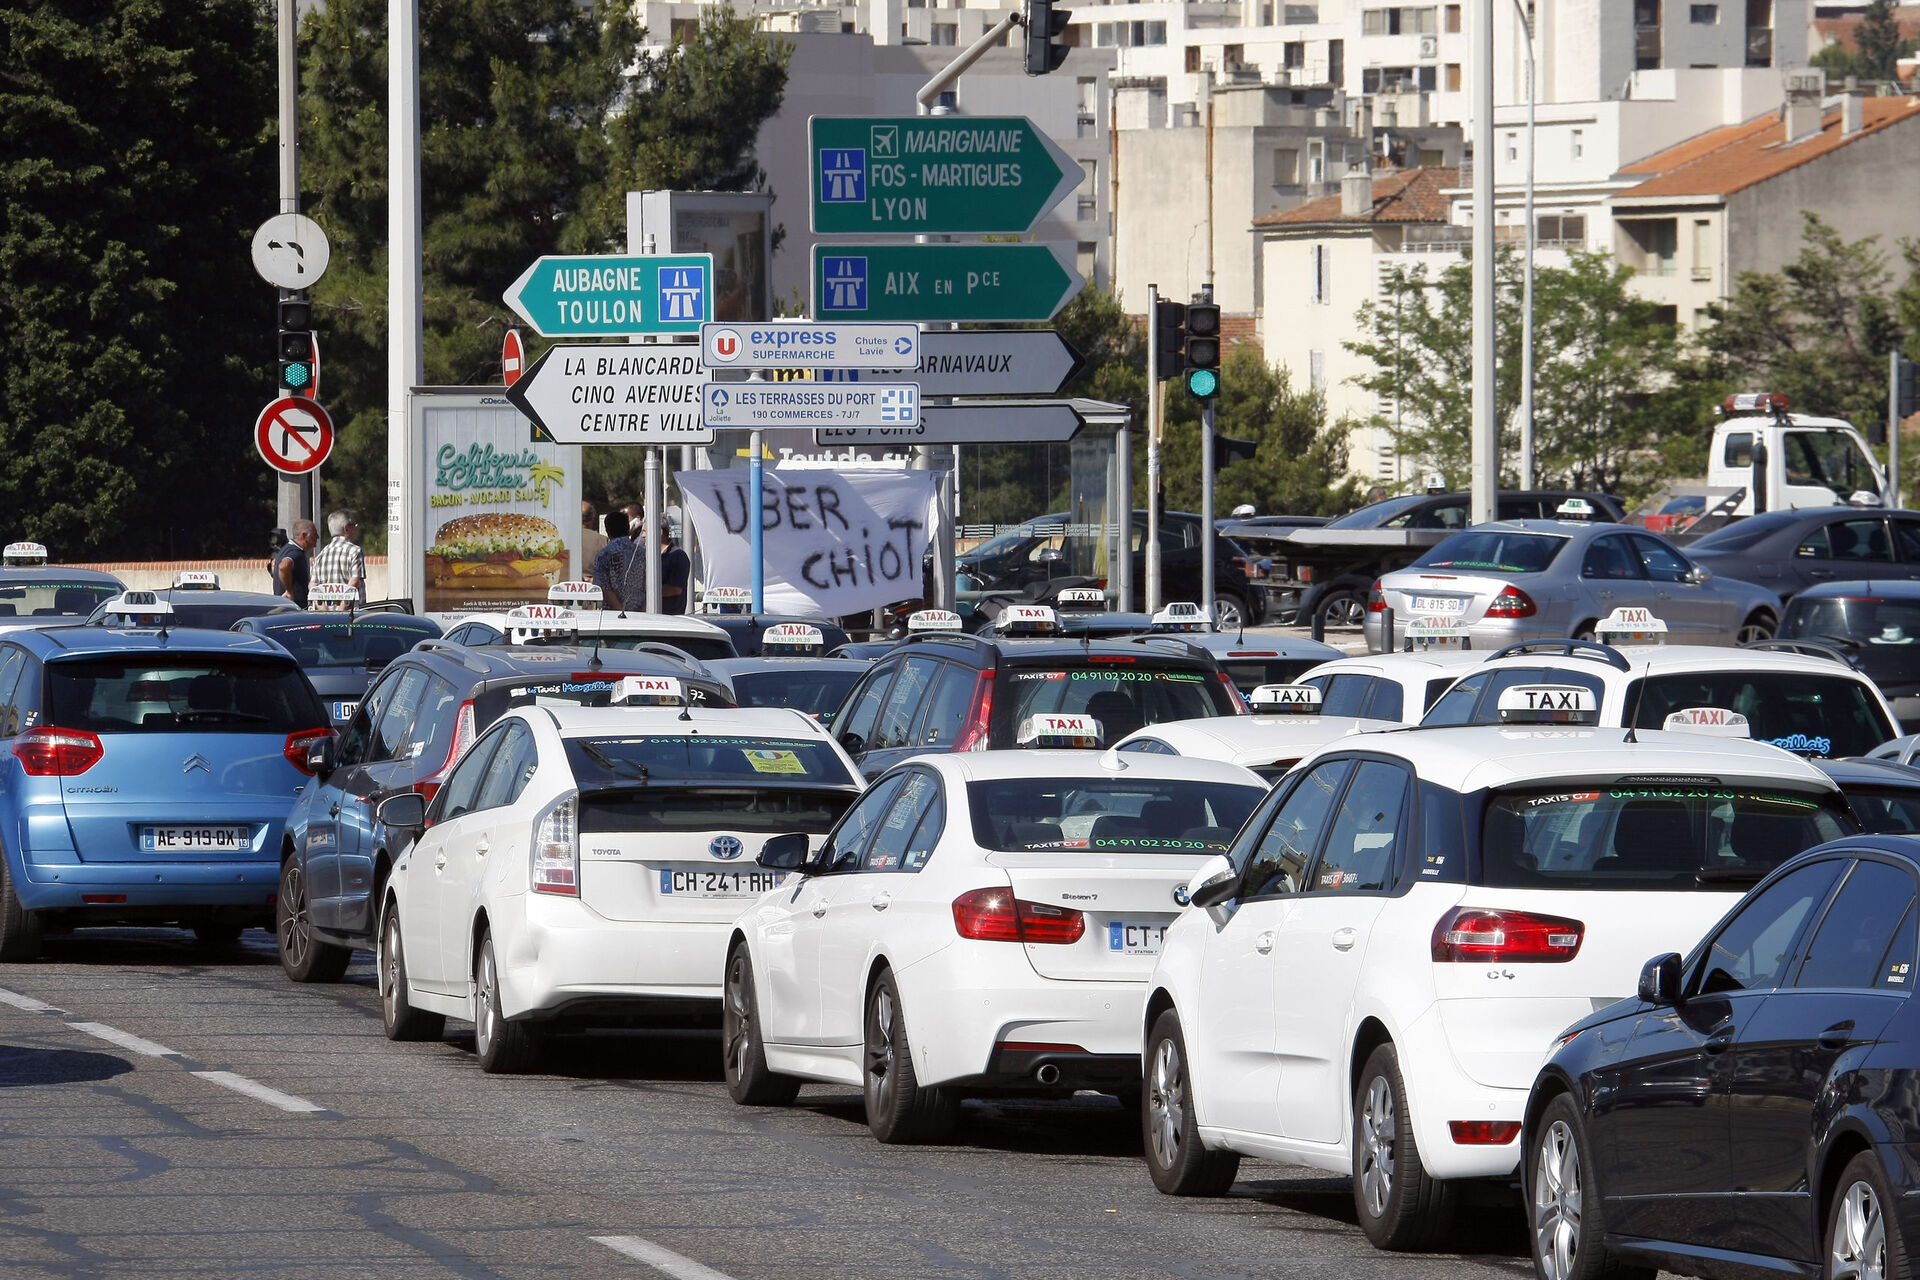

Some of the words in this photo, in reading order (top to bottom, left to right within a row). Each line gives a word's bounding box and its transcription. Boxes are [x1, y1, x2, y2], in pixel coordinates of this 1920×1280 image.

[905, 131, 1022, 153] MARIGNANE
[872, 164, 906, 187] FOS
[922, 164, 1022, 187] MARTIGUES
[872, 198, 927, 221] LYON
[553, 268, 641, 292] AUBAGNE
[885, 272, 919, 295] AIX
[935, 280, 952, 295] EN
[557, 300, 642, 324] TOULON
[751, 330, 837, 348] express
[855, 336, 888, 345] Chutes
[752, 350, 835, 360] SUPERMARCHE
[859, 347, 884, 356] Lavie
[564, 358, 586, 376] LA
[571, 385, 615, 404] CINQ
[736, 393, 757, 405] LES
[759, 393, 825, 405] TERRASSES
[828, 393, 843, 405] DU
[846, 393, 876, 405] PORT
[752, 410, 768, 419] 190
[770, 410, 833, 419] COMMERCES
[842, 410, 860, 419] 7J/7
[580, 414, 650, 432] CENTRE
[436, 441, 541, 475] California
[430, 493, 463, 509] BACON
[470, 489, 512, 505] AVOCADO
[713, 484, 849, 534] UBER
[322, 585, 345, 593] TAXI
[564, 583, 588, 593] TAXI
[129, 592, 155, 605] TAXI
[1071, 592, 1097, 600] TAXI
[526, 607, 557, 619] TAXI
[1017, 609, 1045, 617] TAXI
[1172, 604, 1196, 615] TAXI
[924, 612, 947, 621] TAXI
[1424, 617, 1451, 628] TAXI
[1619, 610, 1647, 623] TAXI
[781, 625, 806, 635] TAXI
[1071, 672, 1088, 681] 04
[1090, 672, 1102, 681] 91
[1104, 672, 1119, 681] 02
[1120, 672, 1135, 681] 20
[1137, 673, 1152, 682] 20
[635, 681, 669, 690] TAXI
[1271, 690, 1311, 702] TAXI
[1525, 692, 1580, 710] TAXI
[1689, 710, 1724, 725] TAXI
[1045, 719, 1083, 729] TAXI
[1528, 794, 1569, 807] TAXIS
[239, 838, 247, 847] 13
[1024, 842, 1061, 850] TAXIS
[1095, 839, 1118, 847] 04
[1120, 839, 1136, 847] 91
[1140, 839, 1160, 847] 02
[1162, 840, 1182, 848] 20
[1185, 841, 1205, 849] 20
[673, 872, 773, 892] CH-241-RH
